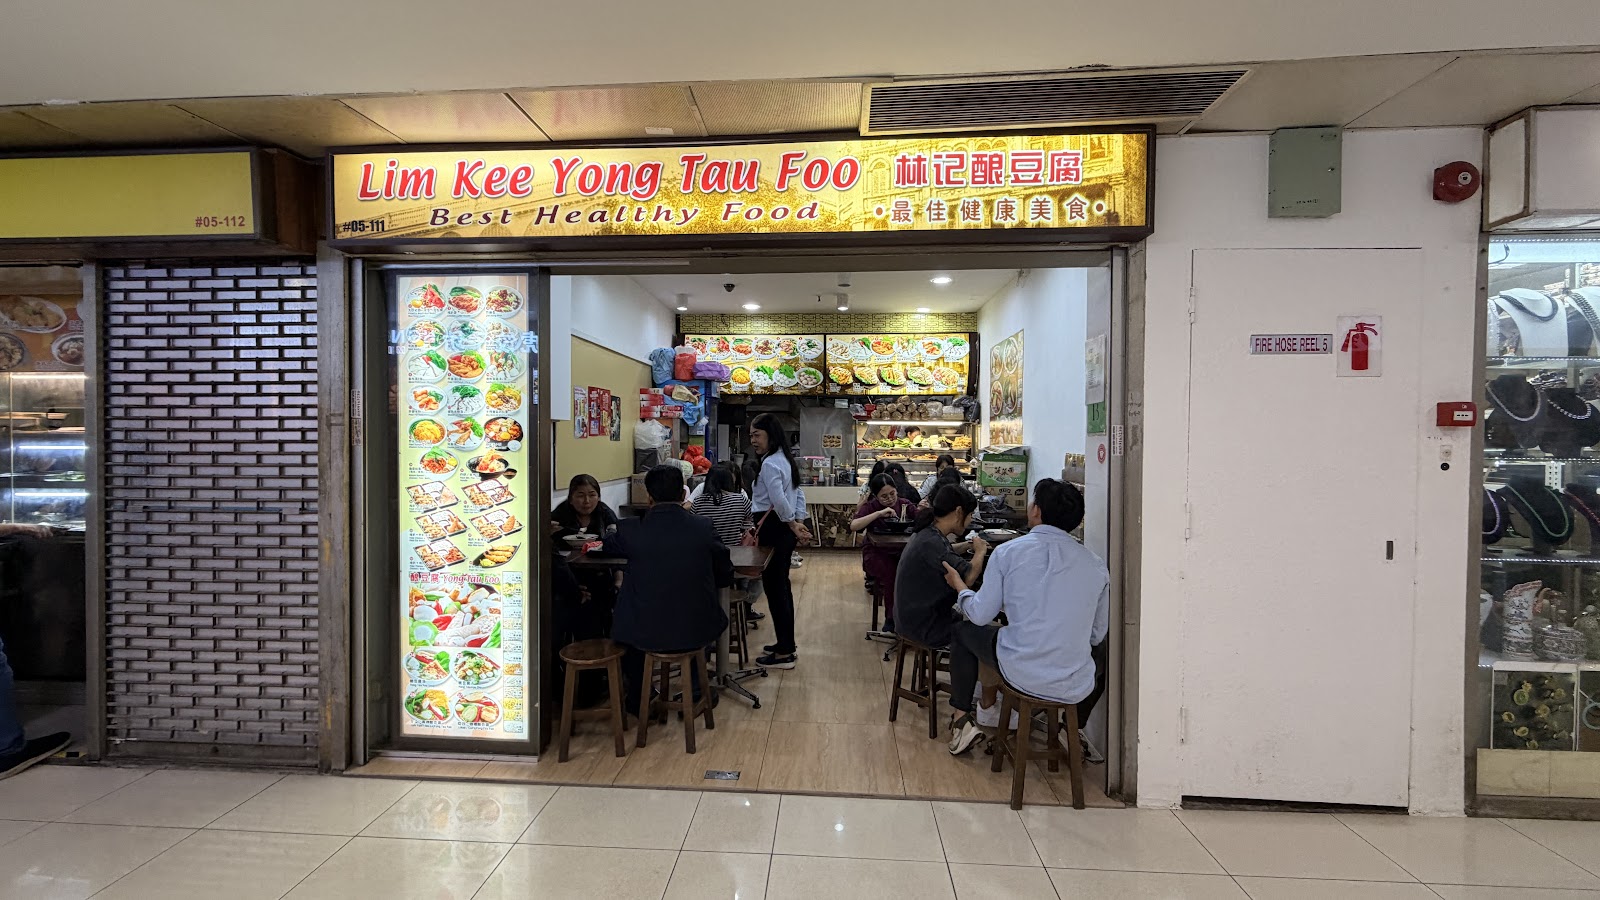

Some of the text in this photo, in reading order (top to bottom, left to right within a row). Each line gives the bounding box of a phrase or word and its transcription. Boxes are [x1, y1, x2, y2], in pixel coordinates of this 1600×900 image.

[358, 151, 861, 200] Lim Kee Yong Tau Foo
[894, 149, 1083, 187] 林记酿豆腐
[195, 216, 245, 227] #05-112
[429, 202, 819, 226] Best Healthy Food
[890, 197, 1089, 223] 最佳健康美食
[342, 219, 386, 233] #05-111
[1255, 337, 1328, 352] FIRE HOSE REEL 5
